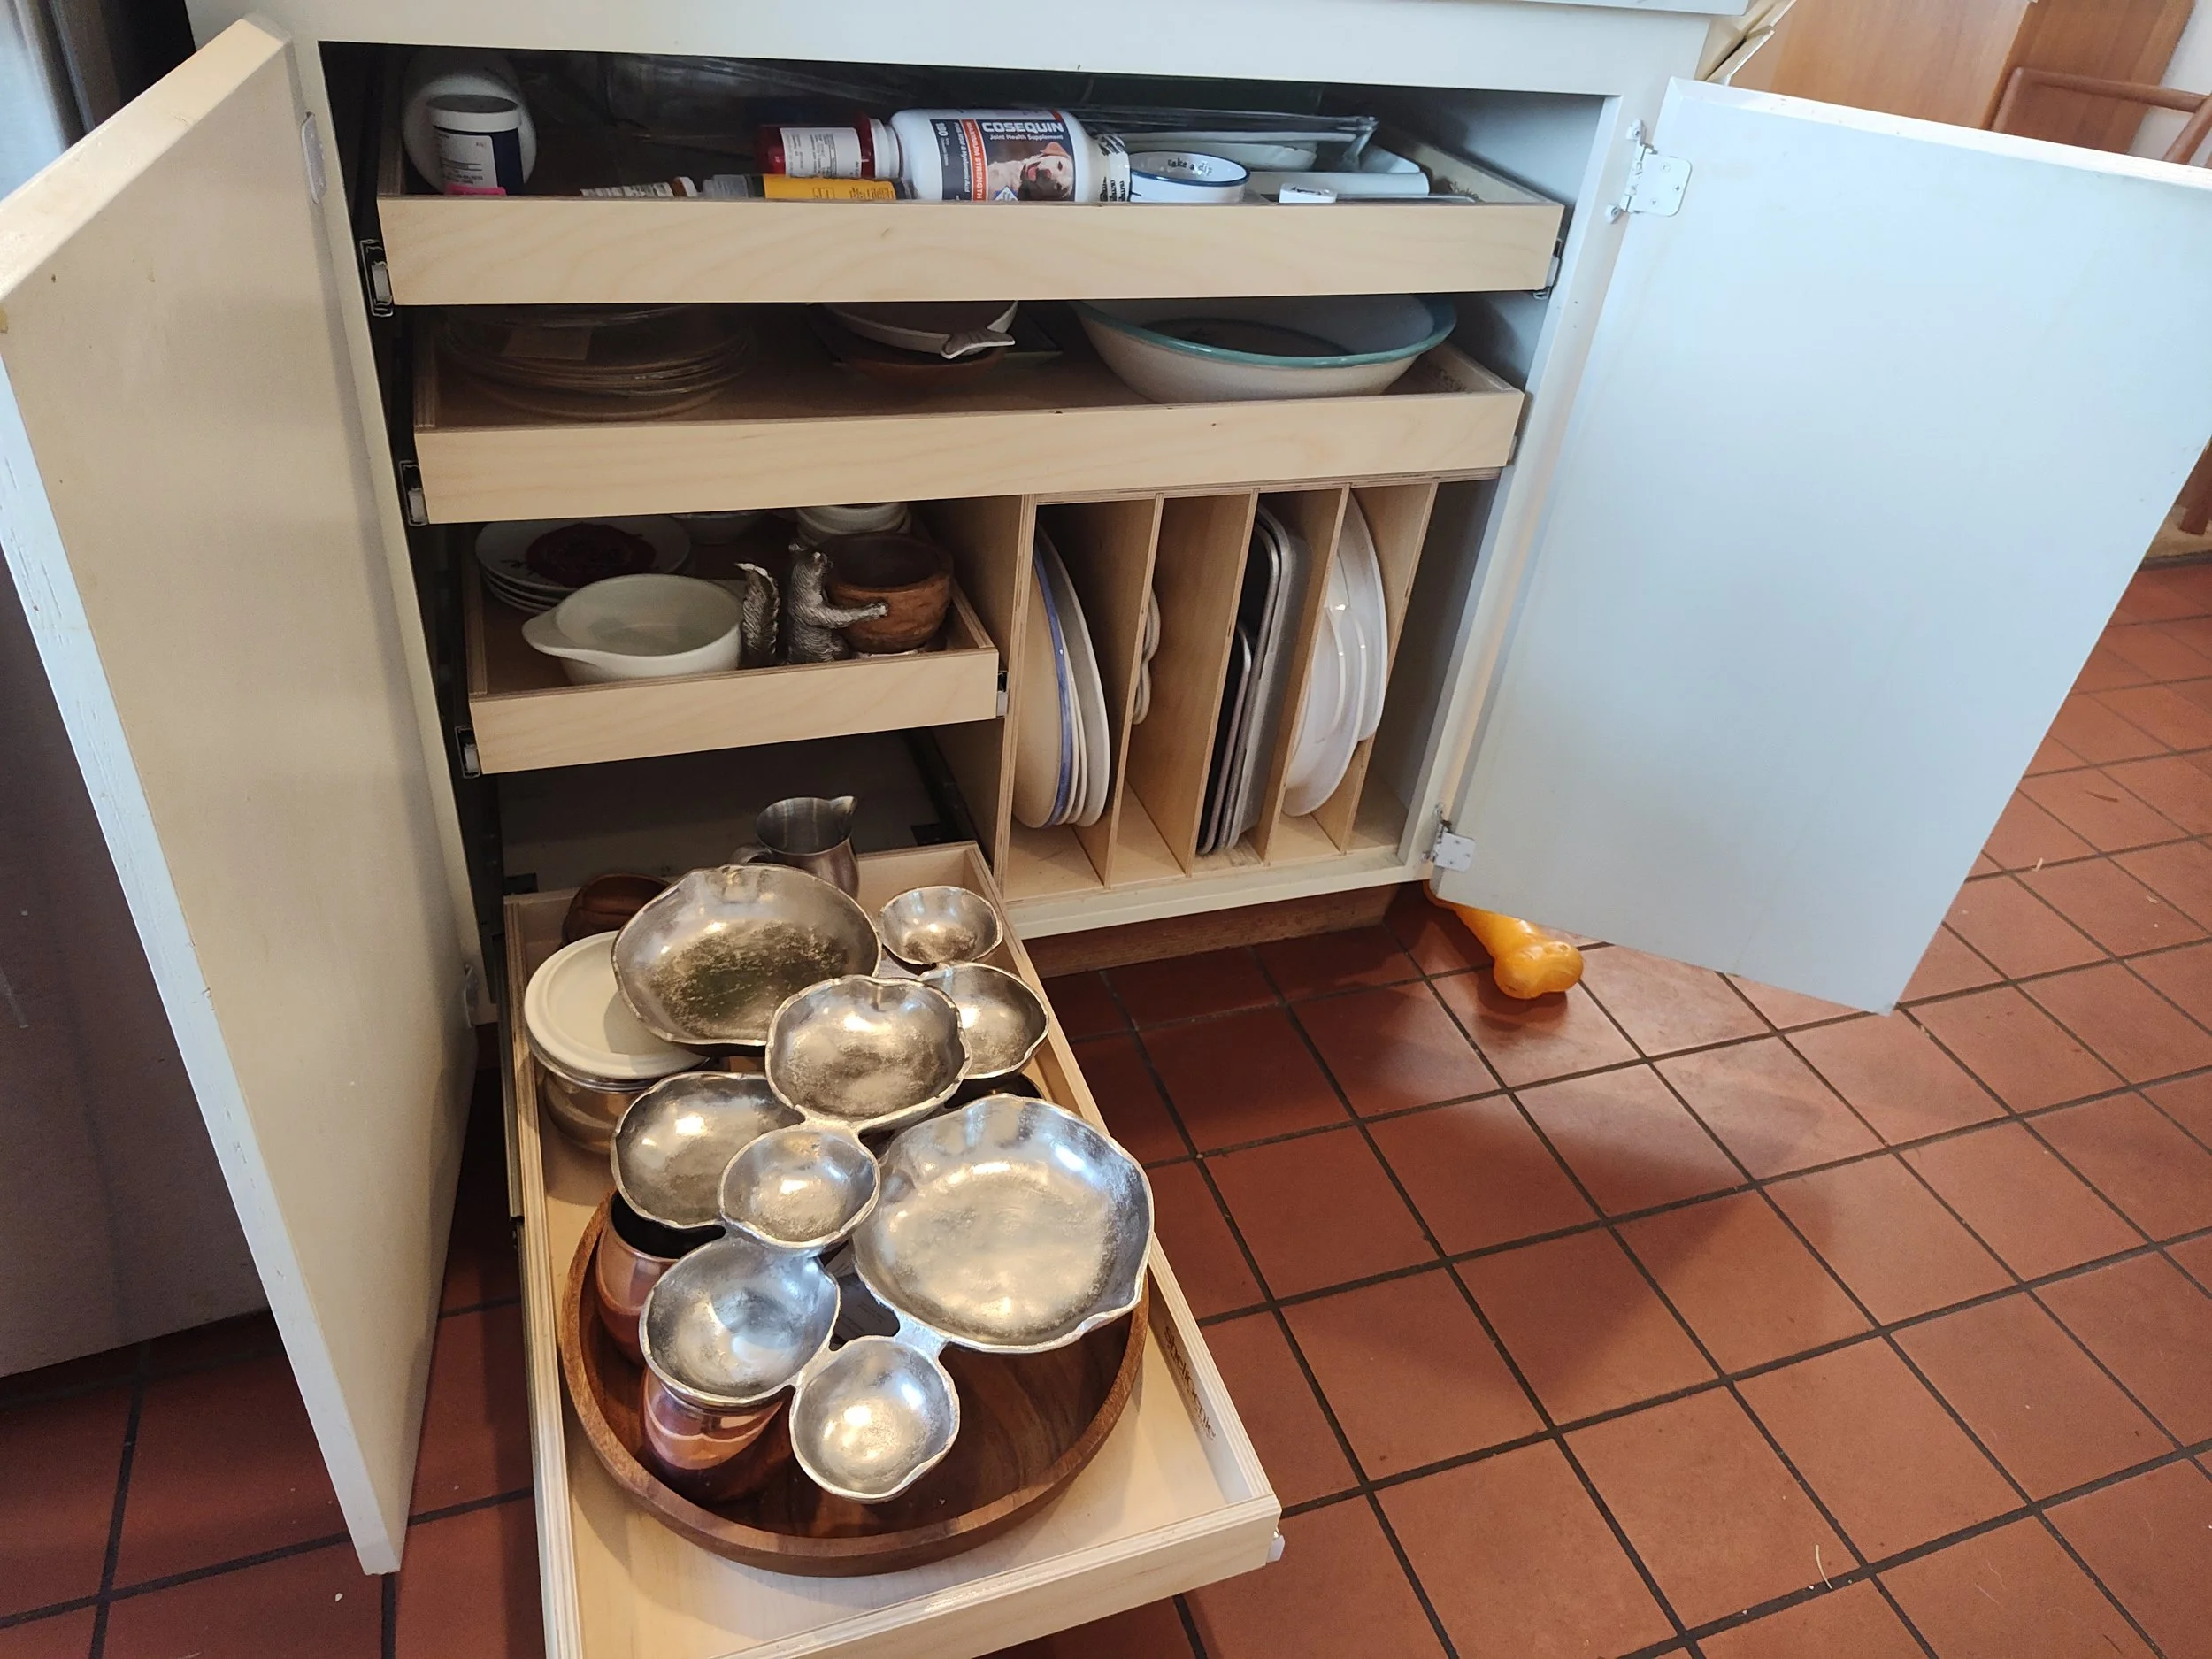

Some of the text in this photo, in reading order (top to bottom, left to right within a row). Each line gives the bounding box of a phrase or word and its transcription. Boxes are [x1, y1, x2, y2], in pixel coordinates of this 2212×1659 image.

[981, 122, 1064, 134] COSEQUIN
[966, 121, 983, 199] MAXIMUM STRENGTH
